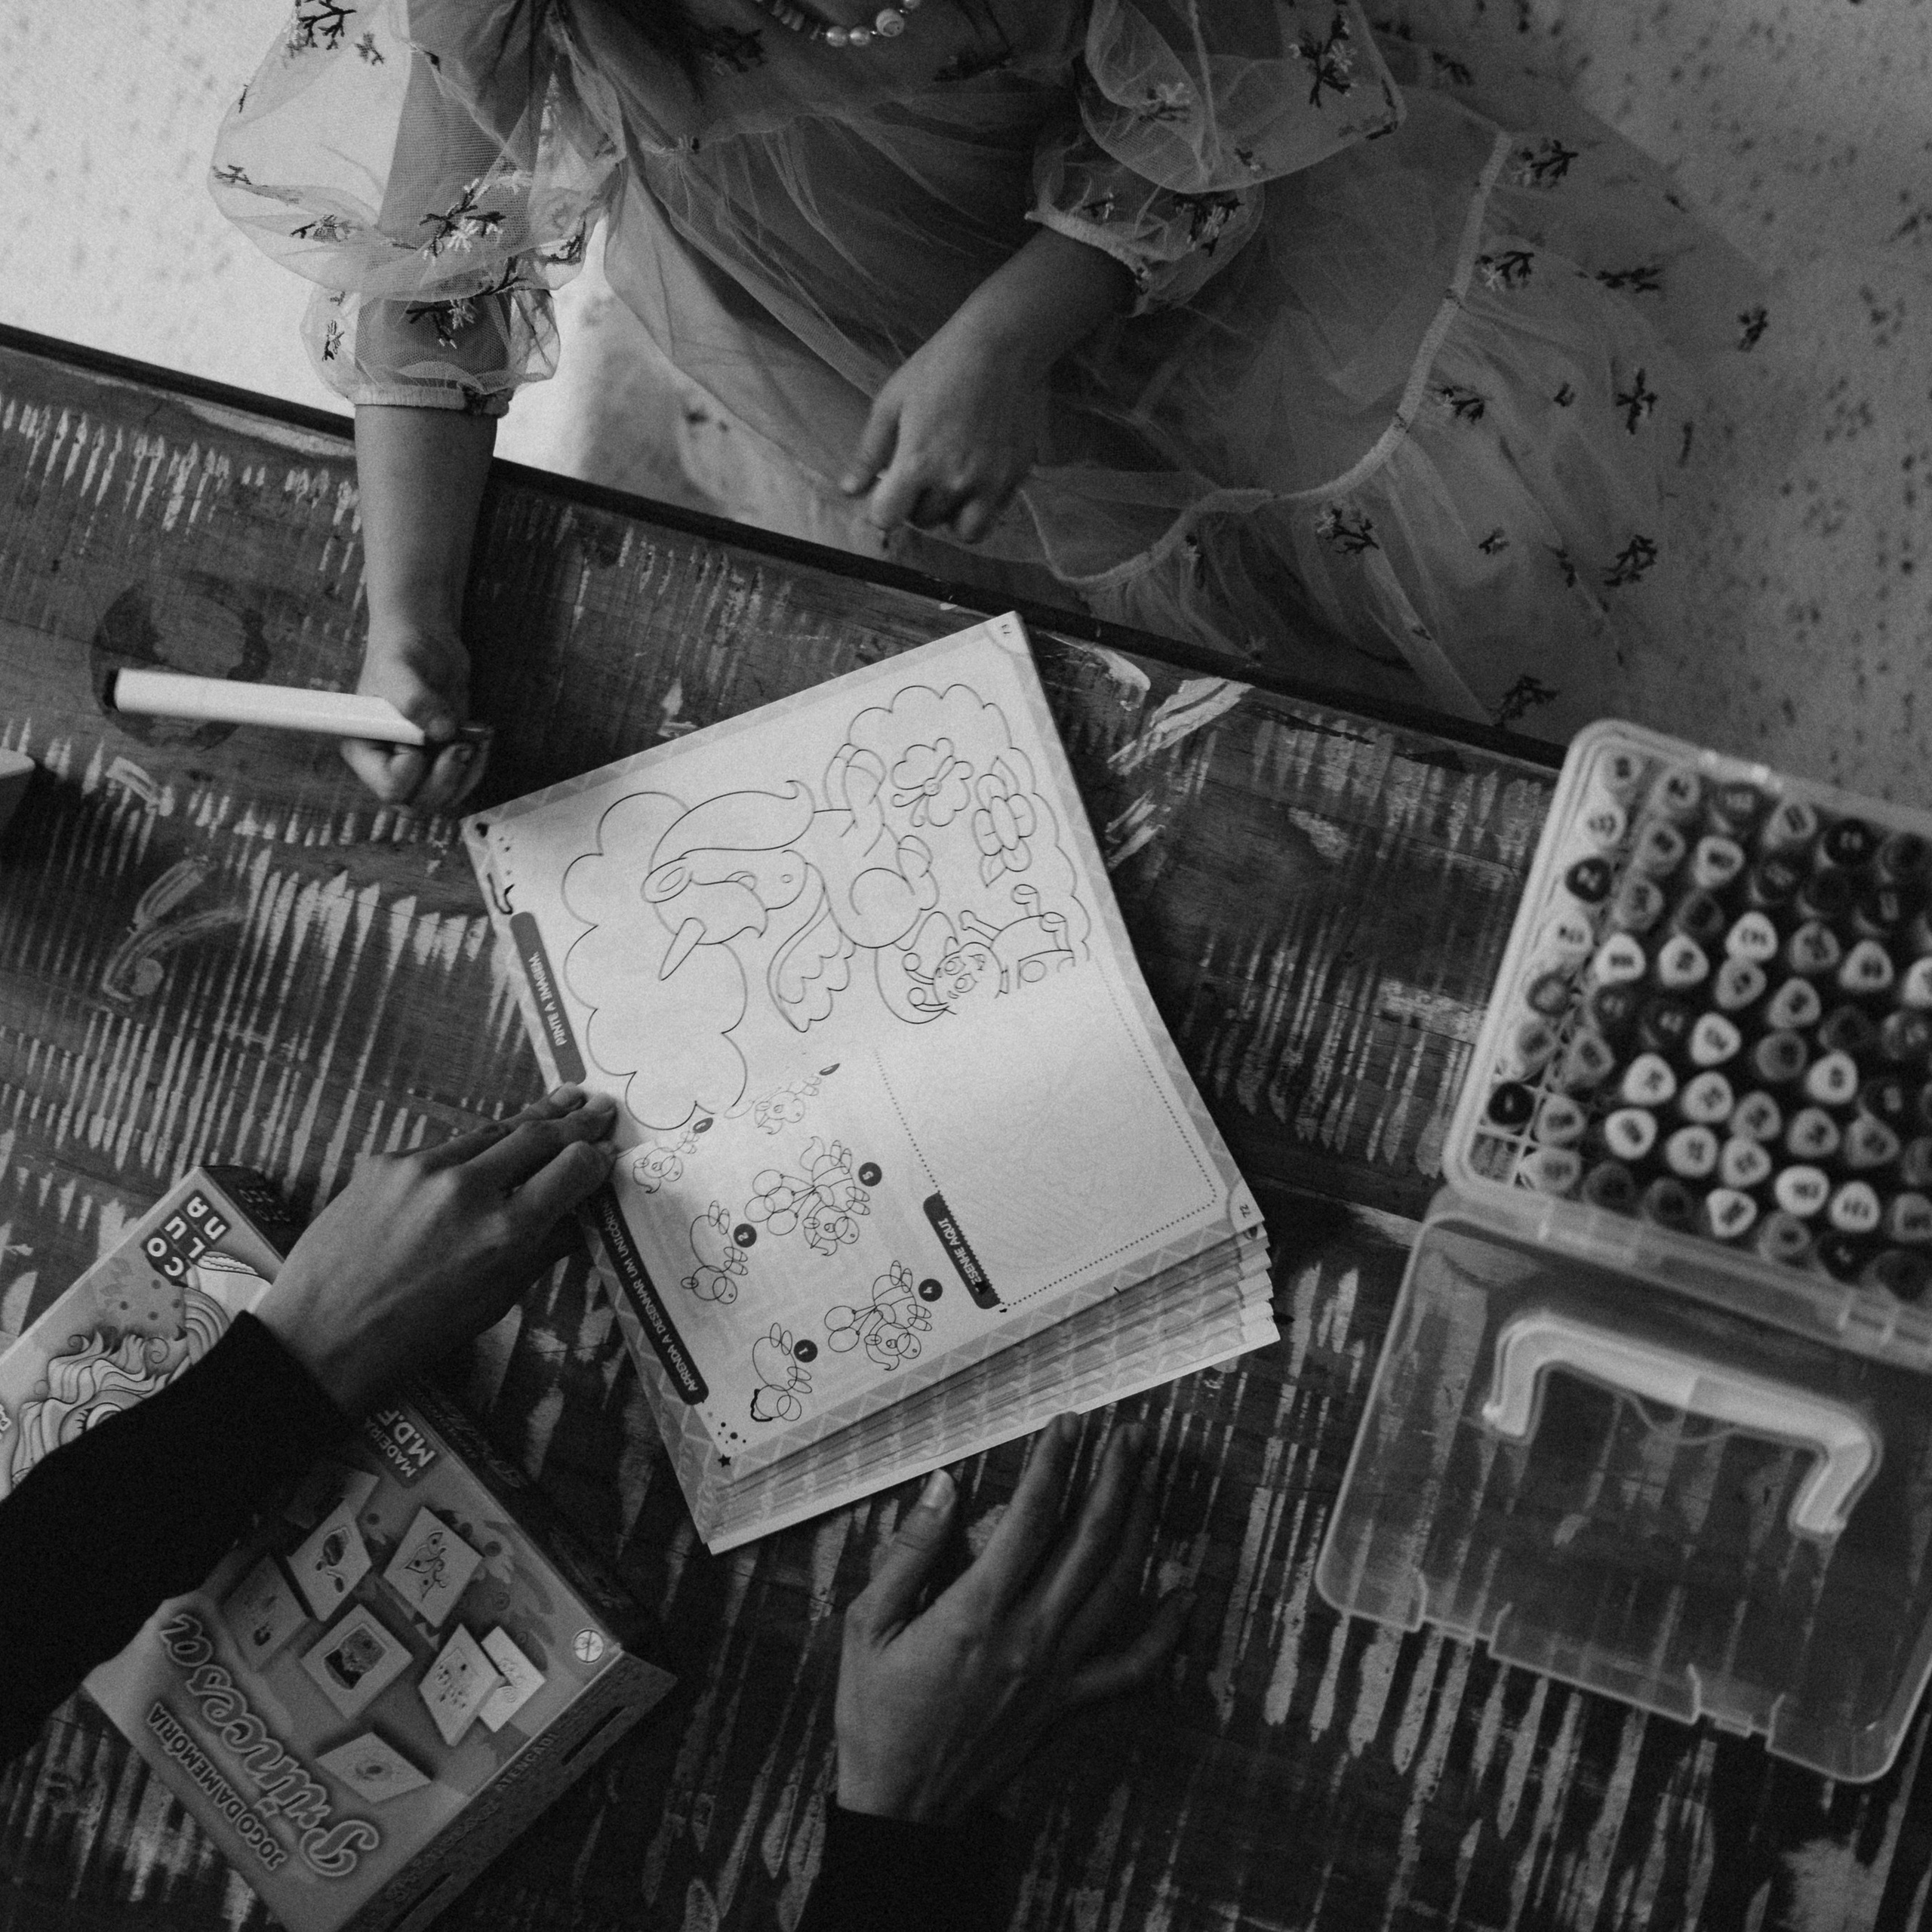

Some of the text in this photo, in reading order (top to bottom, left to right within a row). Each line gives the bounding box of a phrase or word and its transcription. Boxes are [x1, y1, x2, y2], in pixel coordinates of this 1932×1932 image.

[543, 1000, 556, 1011] A
[546, 1011, 568, 1047] PINTE
[861, 1169, 875, 1180] 5
[1238, 1203, 1251, 1219] 72
[736, 1230, 749, 1242] 2
[937, 1217, 986, 1292] ESENHE AQUI
[623, 1257, 638, 1278] UM
[921, 1284, 934, 1296] 4
[632, 1278, 666, 1334] DESENHAR
[661, 1333, 672, 1342] A
[797, 1346, 809, 1356] 1
[666, 1343, 699, 1390] APRENDA
[362, 1416, 417, 1478] MADEIRA
[156, 1611, 377, 1878] Princesa
[146, 1701, 288, 1870] JOGO DA MEMÓRIA
